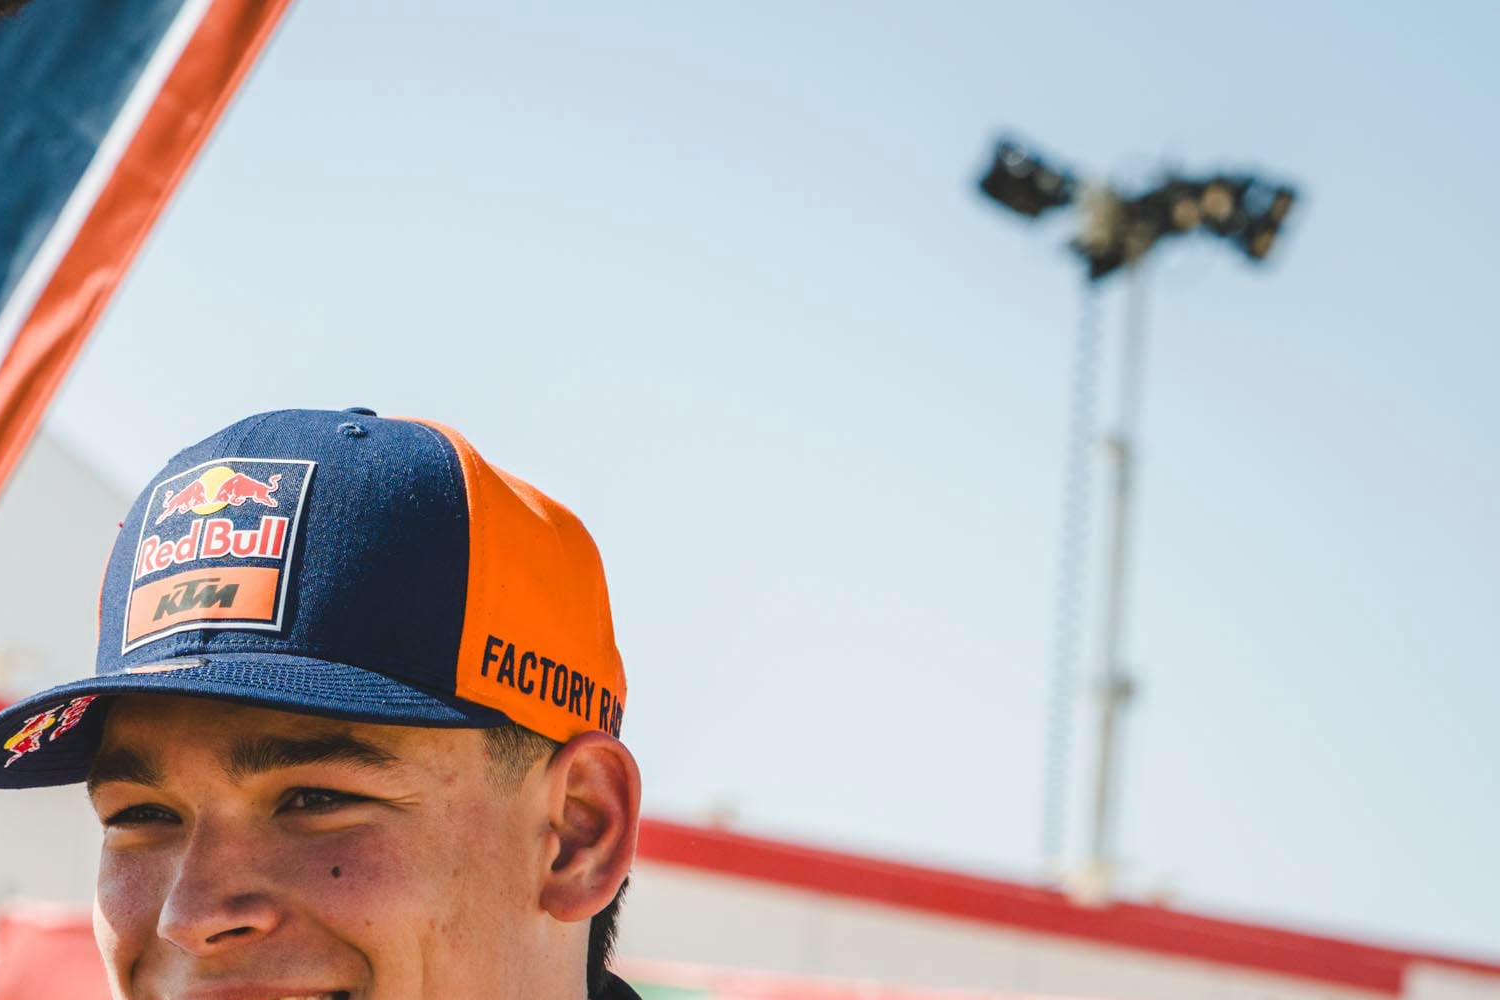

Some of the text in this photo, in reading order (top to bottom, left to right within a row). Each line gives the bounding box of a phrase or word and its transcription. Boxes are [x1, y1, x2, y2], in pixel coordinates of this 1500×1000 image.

[135, 516, 289, 580] Red Bull
[153, 577, 240, 622] KTM
[481, 634, 596, 722] FACTORY
